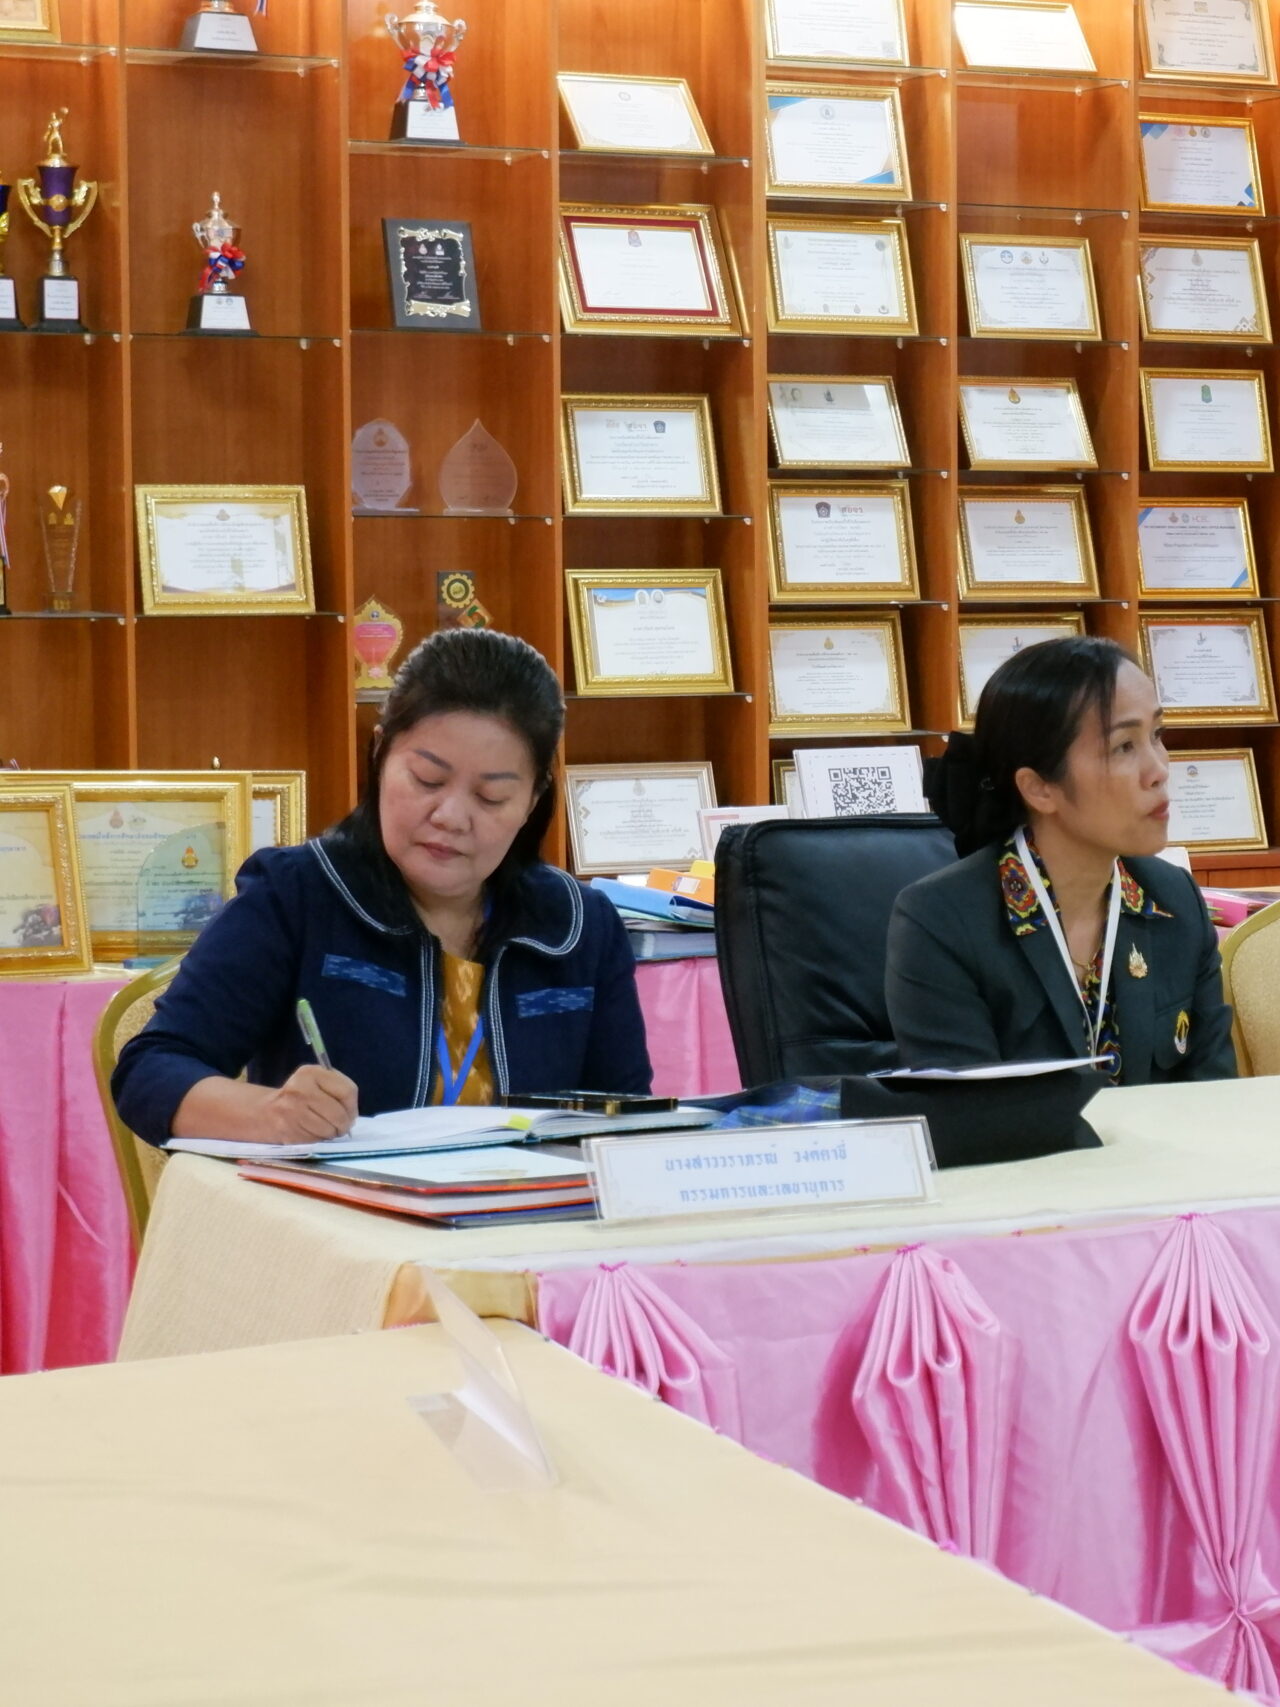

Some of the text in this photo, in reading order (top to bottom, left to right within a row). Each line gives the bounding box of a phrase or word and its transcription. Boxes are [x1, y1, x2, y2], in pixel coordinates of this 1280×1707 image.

[665, 1144, 778, 1172] นางสาววราภรณ์
[680, 1179, 845, 1203] กรรมการและเลขานุการ
